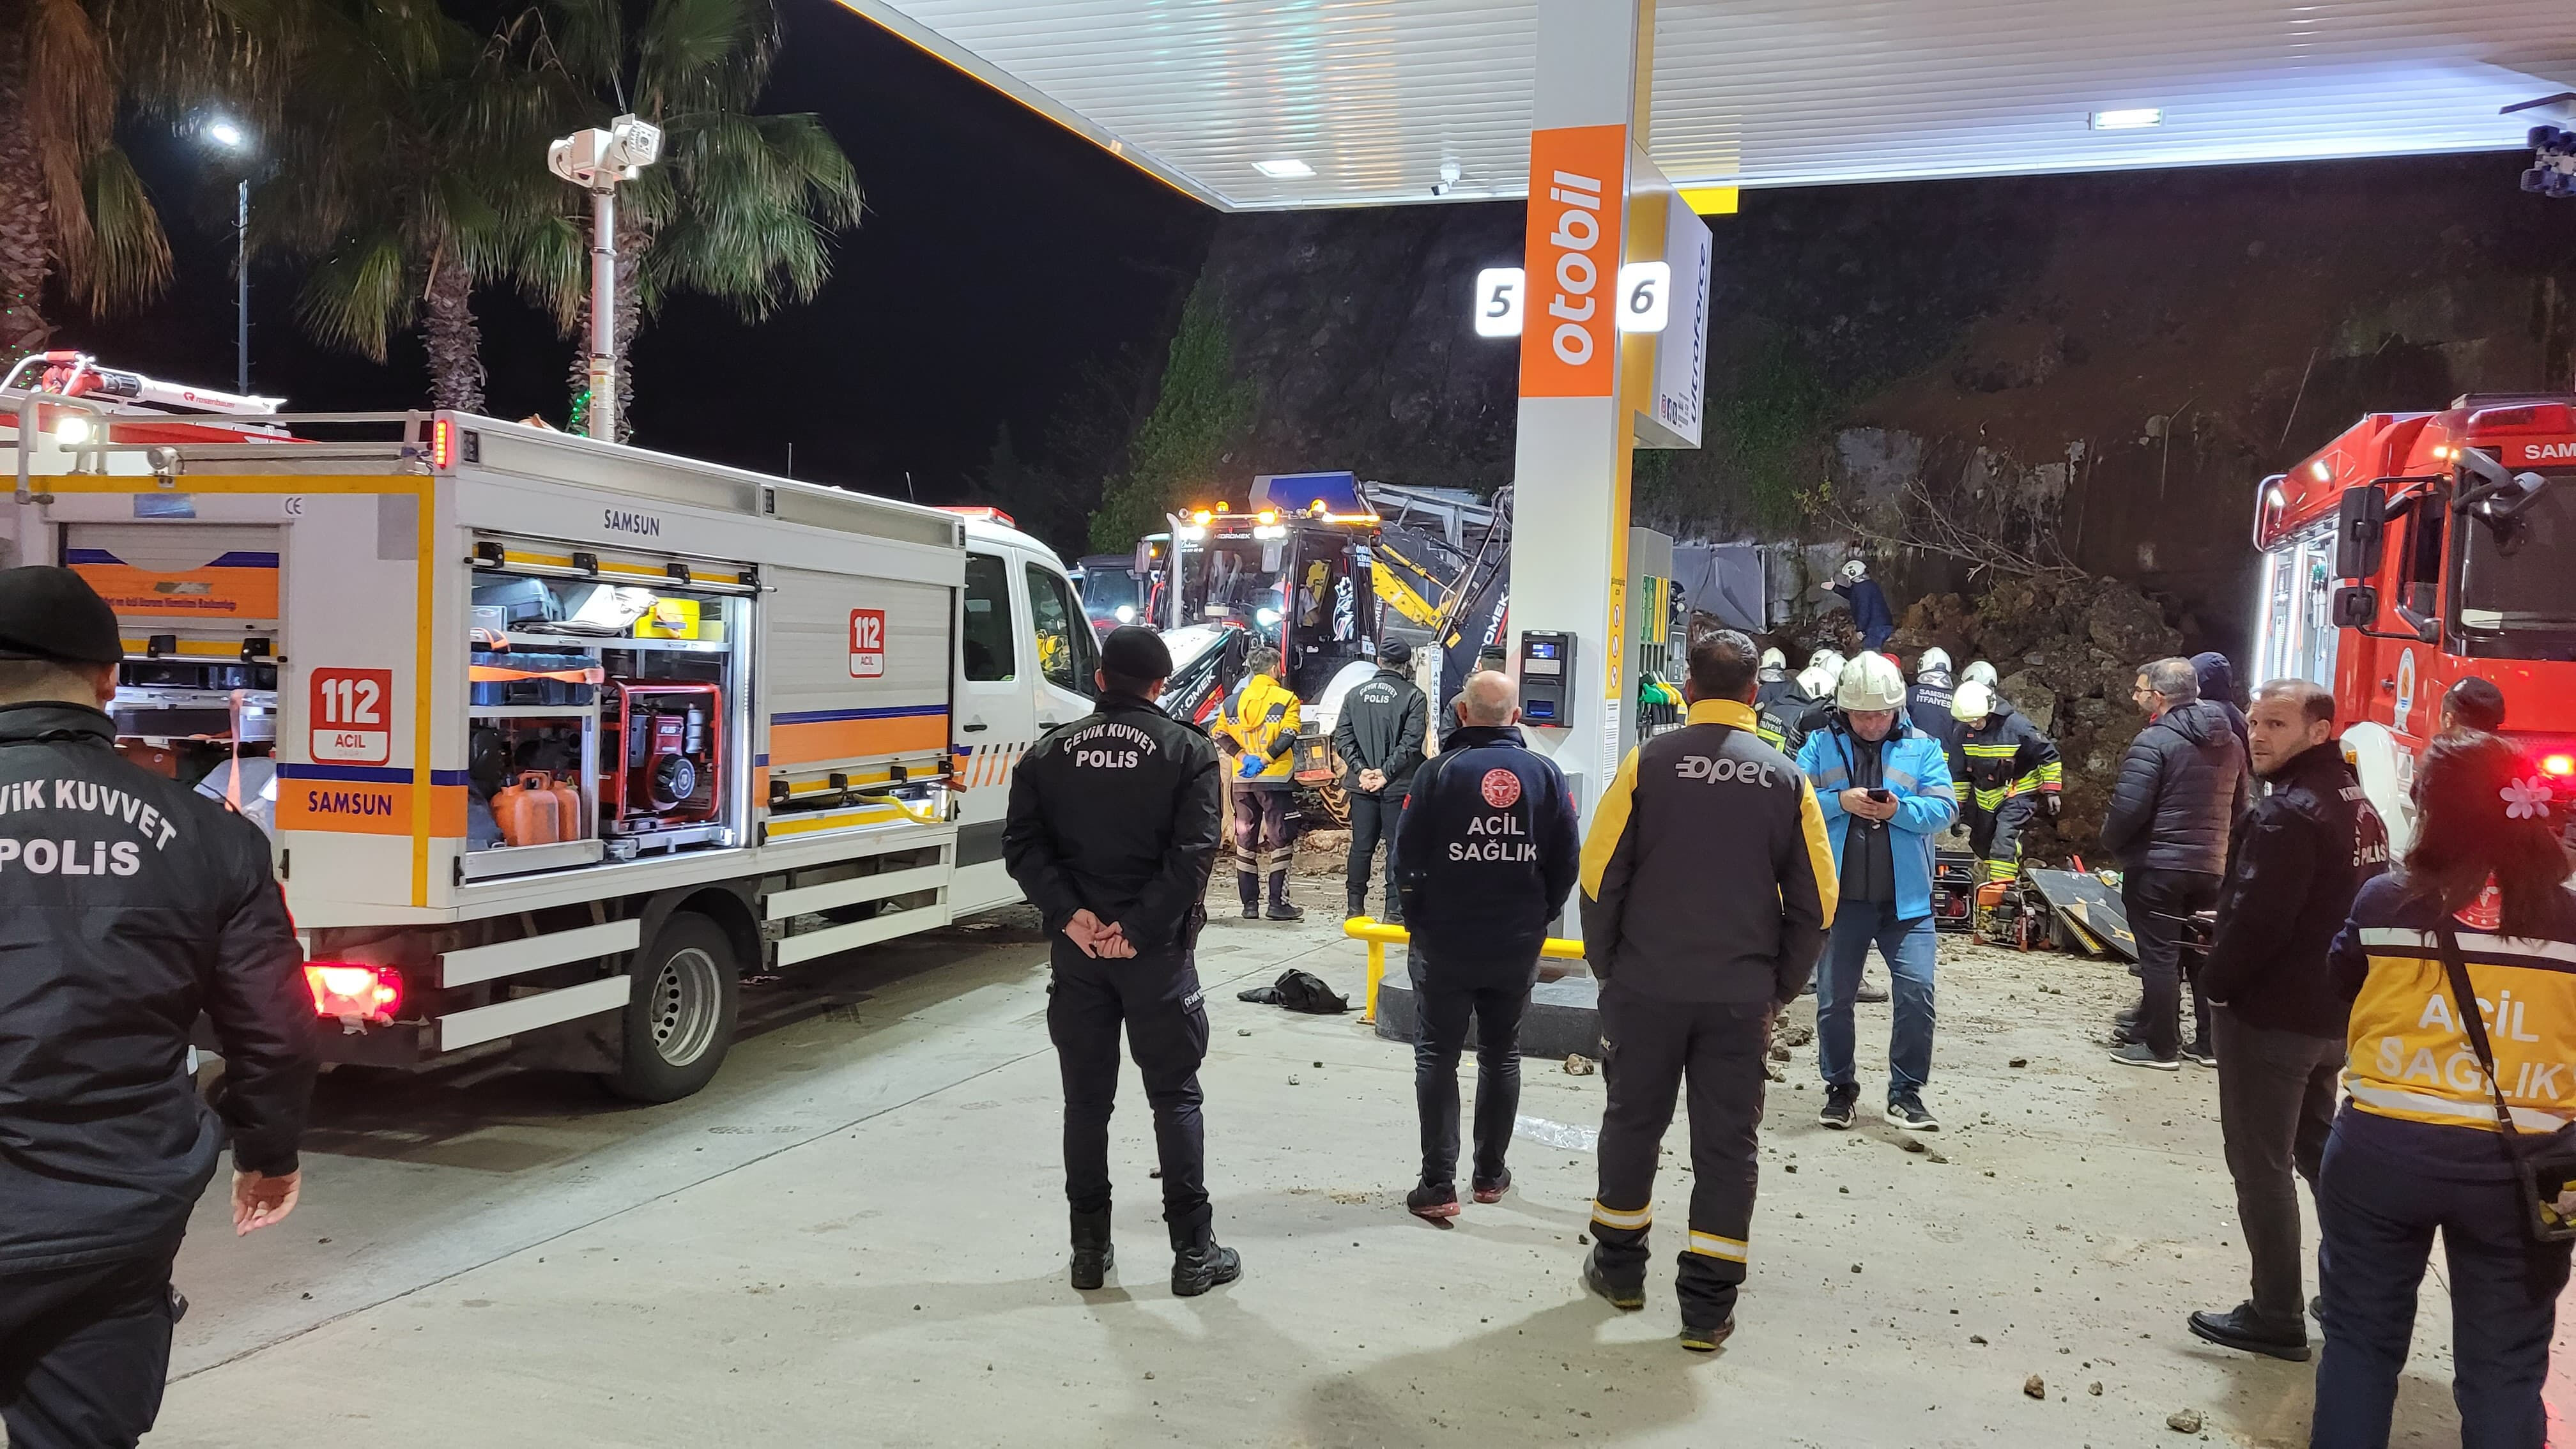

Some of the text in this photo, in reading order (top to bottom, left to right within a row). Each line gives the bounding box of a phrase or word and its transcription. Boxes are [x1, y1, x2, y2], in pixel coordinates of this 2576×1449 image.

[1549, 169, 1602, 365] otobil
[1486, 284, 1513, 318] 5
[1630, 279, 1656, 314] 6
[2525, 443, 2576, 459] SAM
[285, 497, 302, 515] CE
[604, 509, 660, 537] SAMSUN
[854, 617, 880, 648] 112
[321, 678, 380, 724] 112
[1919, 689, 1953, 701] SAMSUN
[1107, 723, 1157, 756] KUVVET
[55, 779, 178, 852] KUVVET
[308, 790, 392, 816] SAMSUN
[1466, 812, 1526, 836] ACİL
[1448, 838, 1537, 862] SAĞLIK
